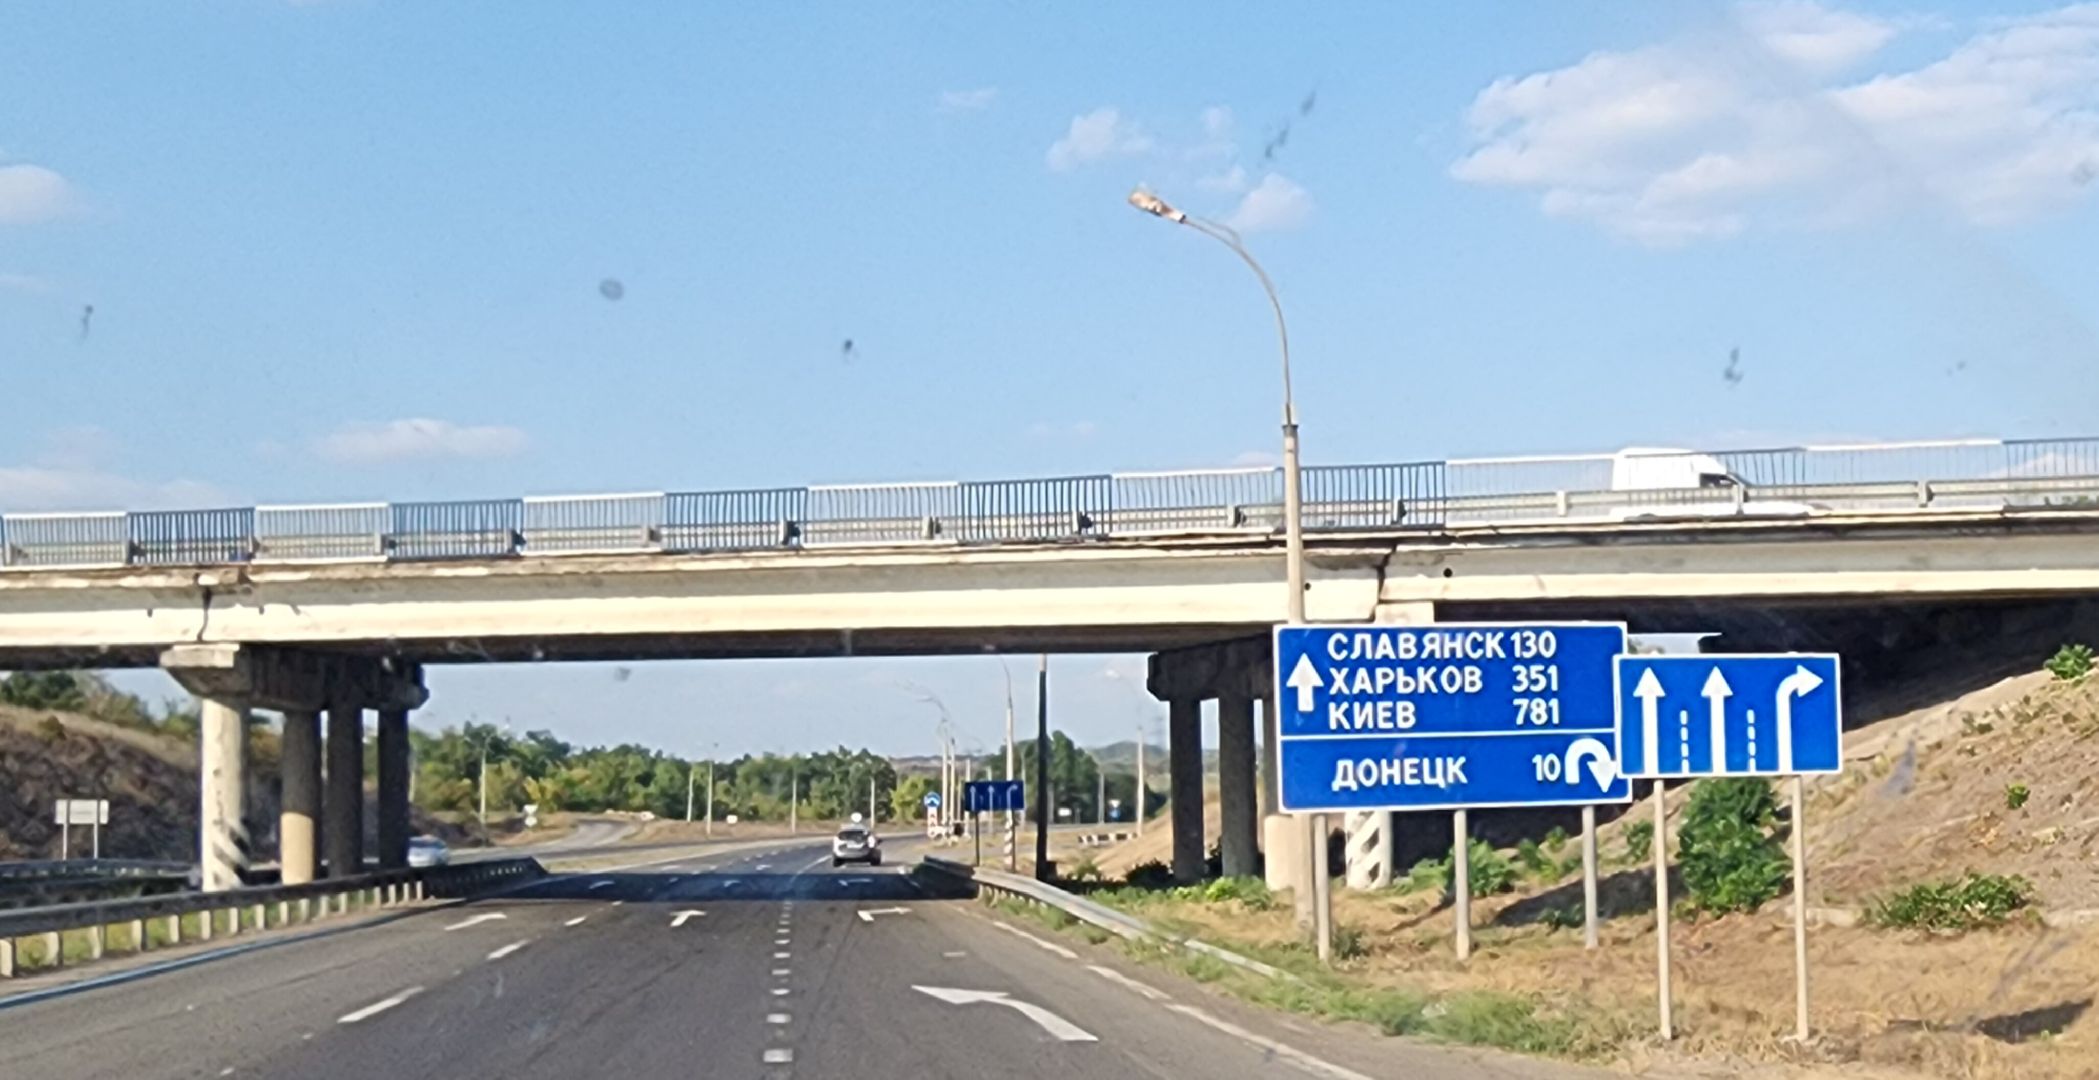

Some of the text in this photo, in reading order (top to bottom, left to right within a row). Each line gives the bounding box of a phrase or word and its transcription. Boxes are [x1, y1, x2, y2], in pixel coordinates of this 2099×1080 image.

[1327, 630, 1557, 661] СЛАВЯНСК 130
[1329, 664, 1559, 695] ХАРЬКОВ 351
[1328, 697, 1560, 730] КИЕВ 781
[1331, 753, 1561, 792] ДОНЕЦК 10
